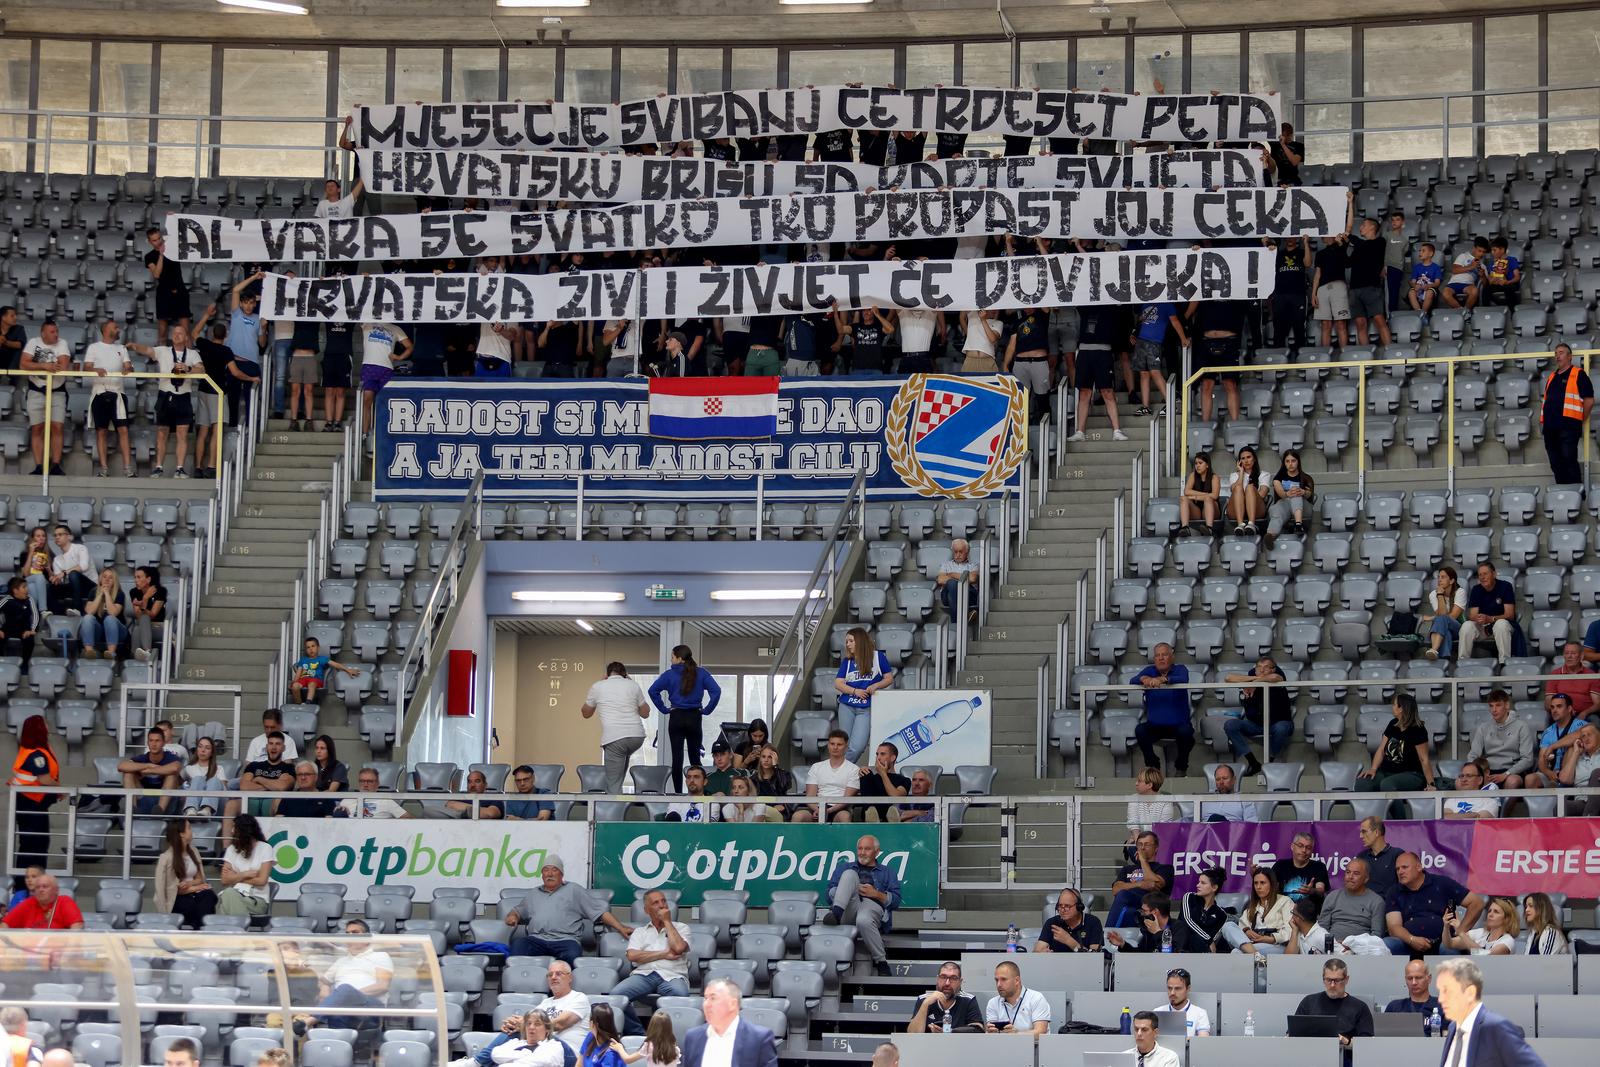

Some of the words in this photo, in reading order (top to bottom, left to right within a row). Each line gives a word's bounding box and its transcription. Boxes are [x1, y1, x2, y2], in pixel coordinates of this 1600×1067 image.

[620, 89, 820, 144] SVIBANJ
[1141, 95, 1277, 141] PETA
[372, 151, 621, 199] HRVATSKU
[795, 164, 859, 195] SA
[261, 218, 400, 261] VARA
[420, 213, 487, 257] SE
[510, 201, 719, 254] SVATKO
[739, 196, 836, 242] TKO
[854, 190, 1081, 241] PROPAST
[1093, 190, 1174, 237] JOJ
[273, 276, 534, 321] HRVATSKA
[665, 271, 677, 315] I
[388, 398, 549, 436] RADOST
[554, 400, 597, 436] SI
[800, 397, 884, 434] DAO
[388, 443, 422, 478] A
[428, 443, 485, 478] JA
[492, 445, 583, 480] TEBI
[589, 444, 783, 480] MLADOST
[550, 662, 557, 671] 8
[561, 662, 568, 671] 9
[573, 662, 584, 671] 10
[549, 697, 558, 706] D
[904, 727, 922, 751] santa
[686, 835, 910, 891] otpbana
[1173, 850, 1248, 876] ERSTE
[1495, 849, 1581, 874] ERSTE
